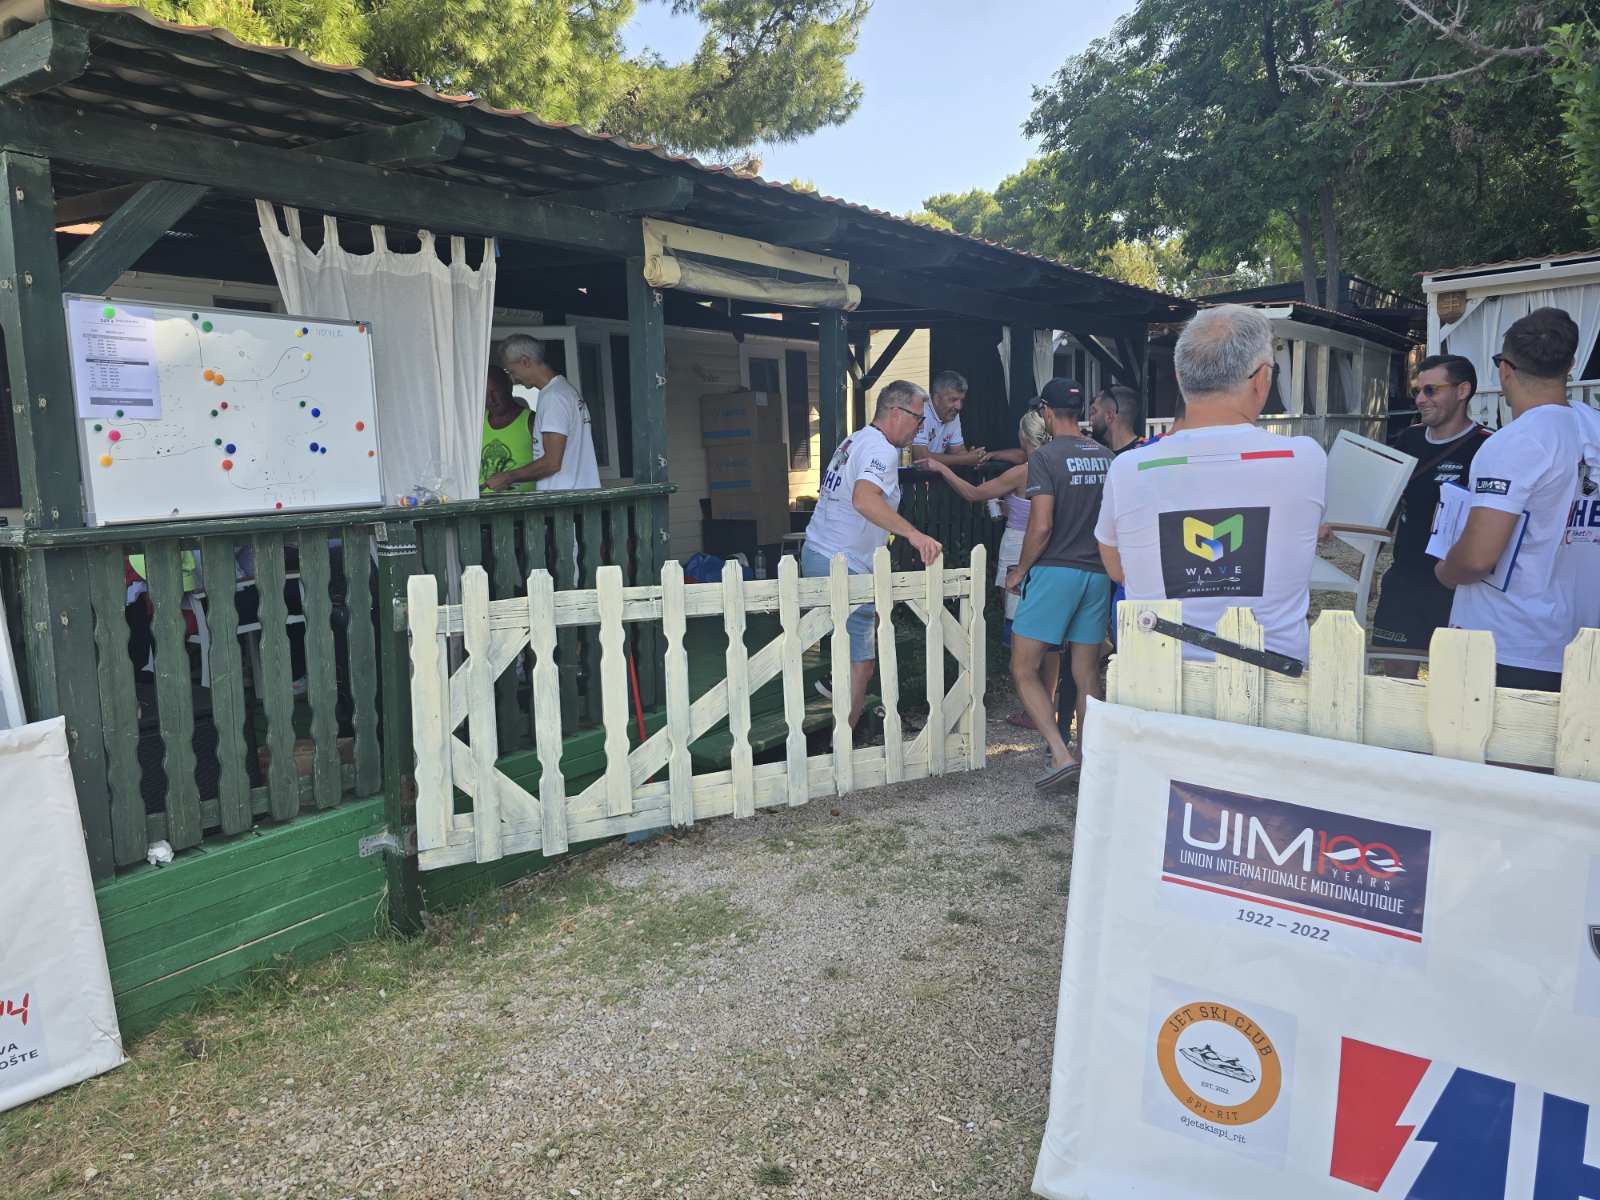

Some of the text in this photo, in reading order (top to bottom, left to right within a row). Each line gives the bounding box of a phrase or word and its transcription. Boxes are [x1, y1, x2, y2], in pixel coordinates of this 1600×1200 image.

[1066, 456, 1112, 472] CROATI
[1070, 474, 1083, 485] JET
[1185, 565, 1242, 576] WAVE
[1182, 802, 1314, 872] UIM
[1180, 849, 1405, 914] UNION INTERNATIONALE MOTONAUTIQUE
[1332, 868, 1391, 891] YEARS
[1236, 908, 1273, 928] 1922
[1290, 922, 1331, 942] 2022
[1169, 1006, 1273, 1057] JET SKI CLUB
[1186, 1096, 1239, 1120] SPI-RIT
